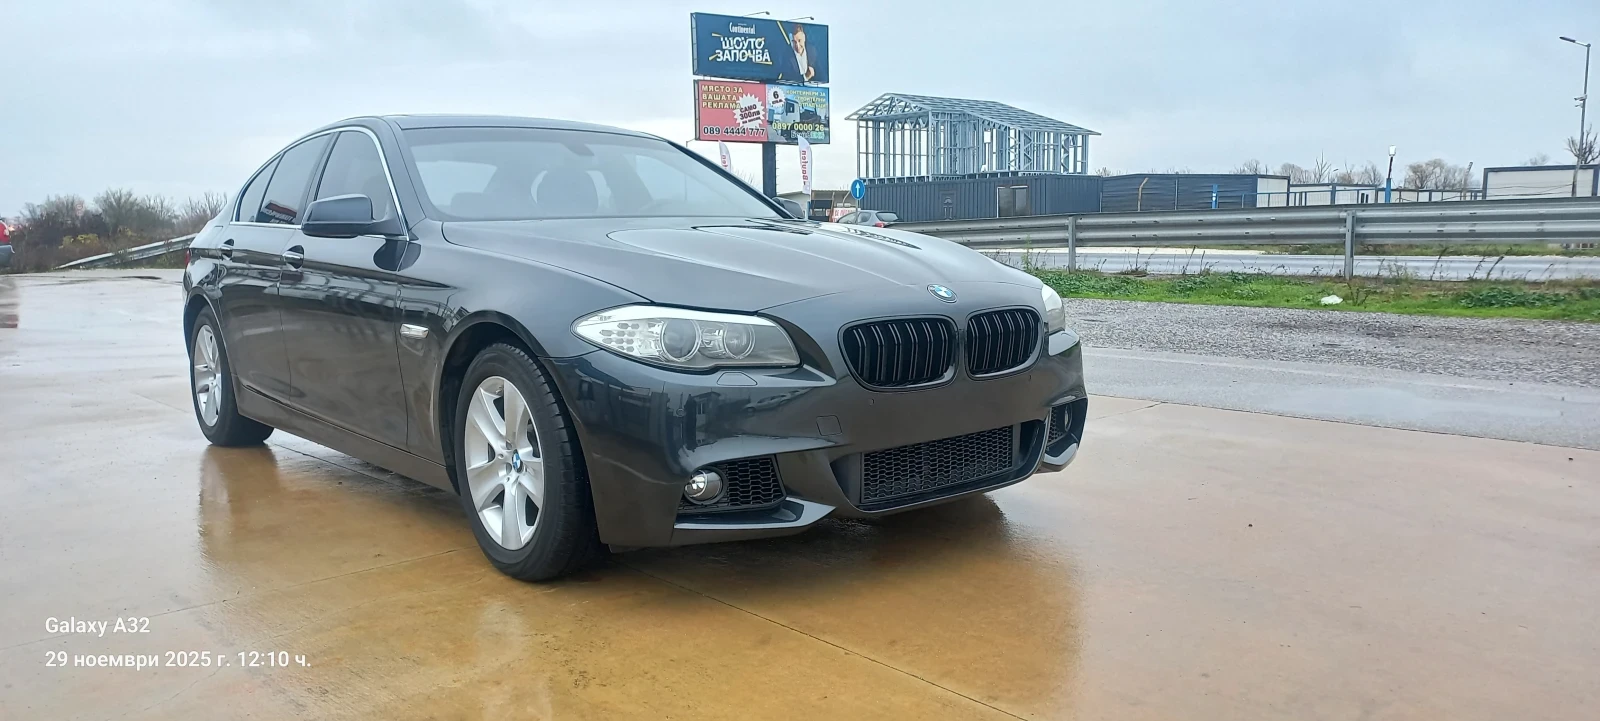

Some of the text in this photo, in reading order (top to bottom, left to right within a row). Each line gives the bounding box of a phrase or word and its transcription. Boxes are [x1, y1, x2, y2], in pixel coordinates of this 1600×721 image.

[729, 22, 756, 34] Continental
[720, 36, 765, 50] ШОУТО
[715, 49, 771, 62] ЗАПОЧВА
[702, 85, 731, 93] МЯСТО
[702, 93, 737, 101] ВАШАТА
[773, 91, 779, 99] 6
[702, 101, 741, 109] РЕКЛАМА
[740, 104, 757, 113] САМО
[703, 126, 766, 136] 089 4444 777
[772, 122, 791, 130] 0897
[793, 123, 813, 131] 0000
